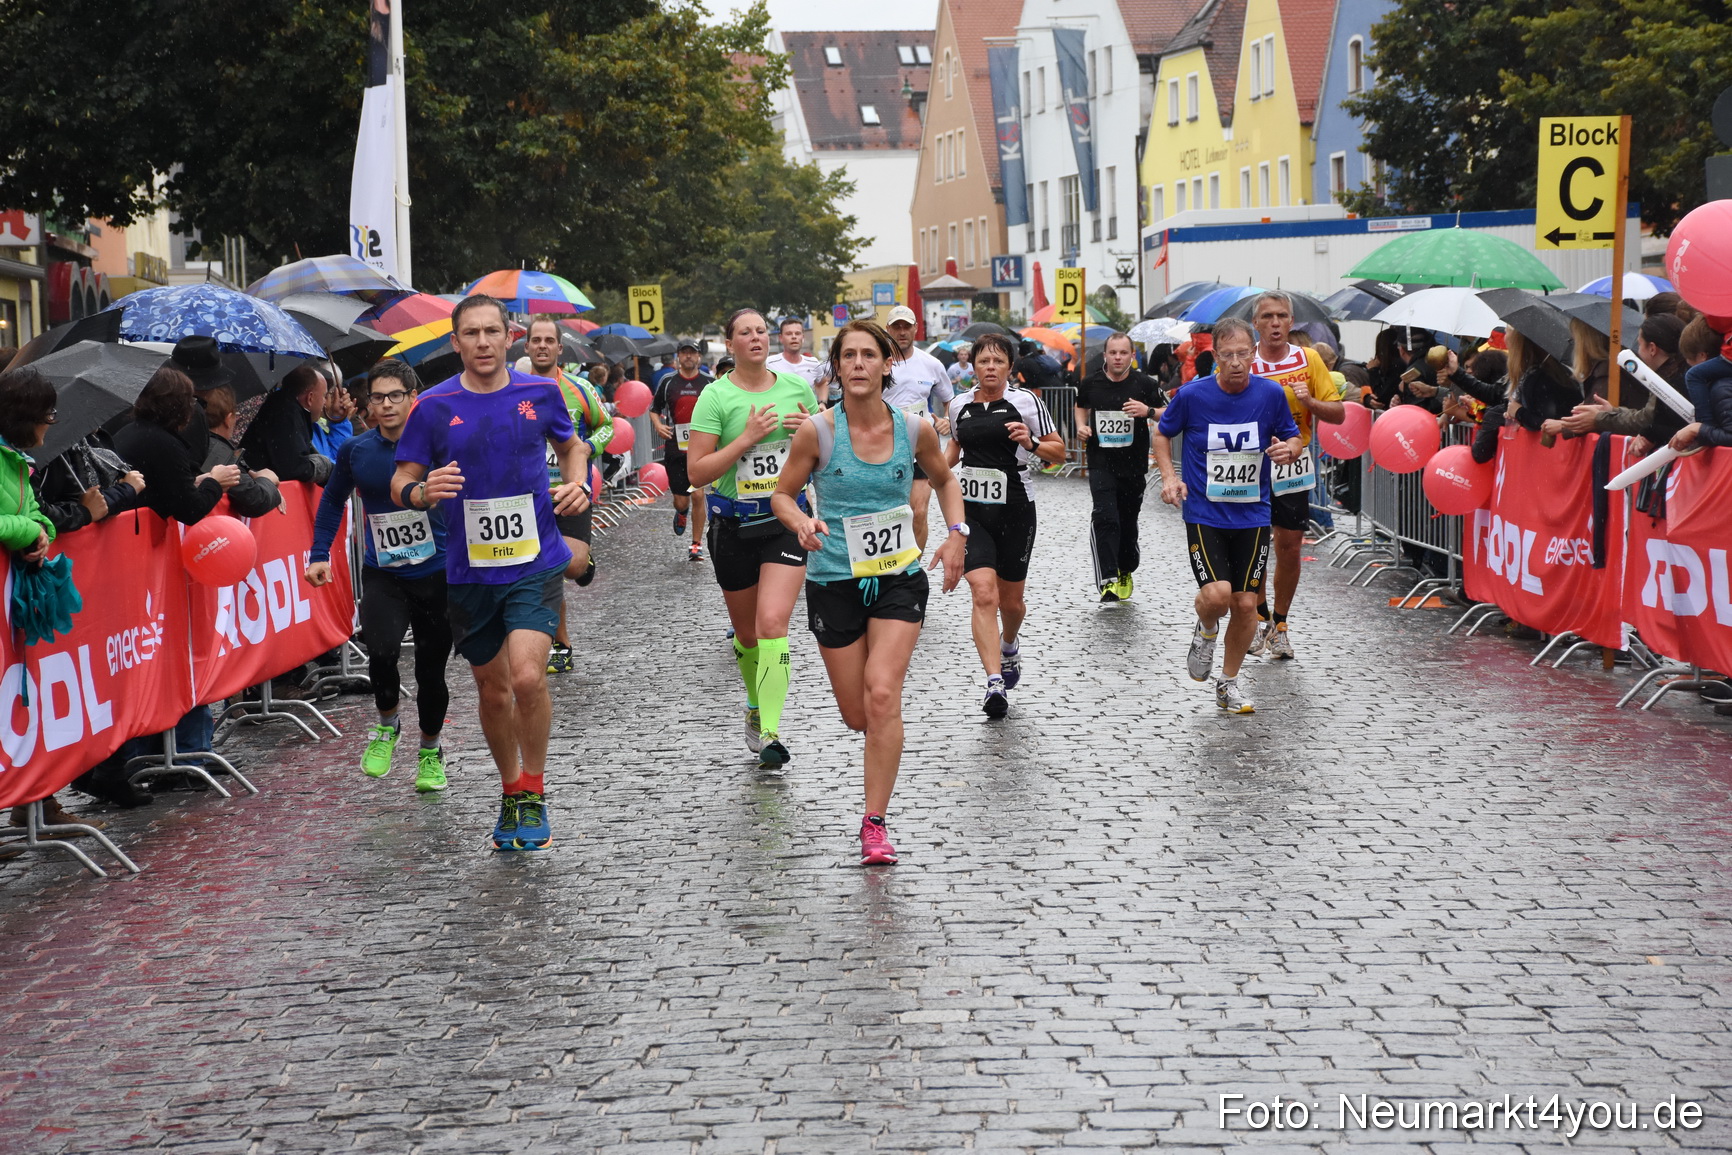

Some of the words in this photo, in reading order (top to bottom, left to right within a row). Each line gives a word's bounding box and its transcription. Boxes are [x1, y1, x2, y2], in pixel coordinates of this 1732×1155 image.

[1550, 122, 1619, 146] Block
[1180, 149, 1200, 171] HOTEL
[1559, 156, 1605, 221] C
[1058, 270, 1082, 279] Block
[632, 288, 657, 297] Block
[1063, 283, 1078, 306] D
[638, 300, 655, 324] D
[1279, 372, 1311, 386] BÖGL
[1100, 420, 1131, 434] 2325
[753, 455, 779, 477] 58
[1213, 464, 1257, 483] 2442
[960, 478, 1002, 500] 3013
[1221, 488, 1248, 496] Johann
[494, 498, 528, 510] BOCK
[479, 513, 523, 541] 303
[863, 523, 902, 557] 327
[390, 549, 420, 560] Patrick
[493, 546, 514, 557] Fritz
[1253, 545, 1268, 579] SKINS
[879, 560, 897, 571] Lisa
[1192, 551, 1208, 581] SKINS
